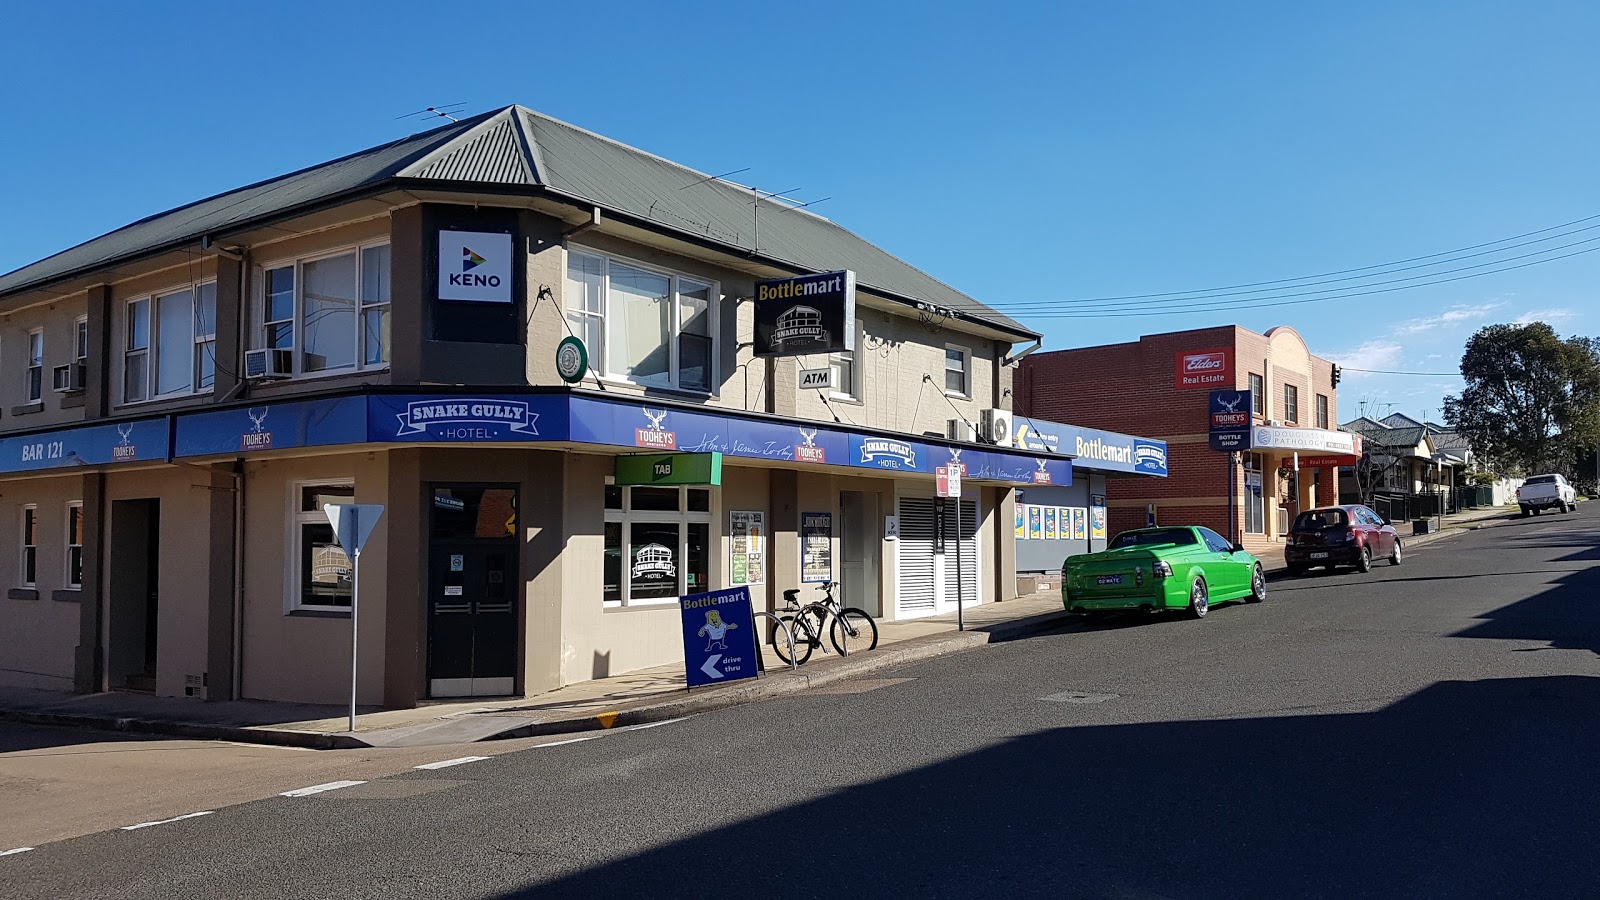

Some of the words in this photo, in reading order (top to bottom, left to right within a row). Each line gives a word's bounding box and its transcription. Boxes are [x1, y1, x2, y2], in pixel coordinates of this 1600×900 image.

[450, 273, 500, 288] KENO
[760, 275, 841, 300] Bottlemart
[777, 328, 799, 338] SNAKE
[799, 327, 820, 335] GULLY
[1187, 358, 1221, 370] Elders
[803, 372, 828, 385] ATM
[1183, 376, 1200, 385] Real
[1201, 374, 1225, 383] Estate
[413, 405, 468, 420] SNAKE
[471, 404, 524, 419] GULLY
[1215, 414, 1245, 422] TOOHEYS
[243, 432, 271, 446] TOOHEYS
[446, 428, 492, 439] HOTEL
[638, 430, 673, 444] TOOHEYS
[867, 442, 889, 452] SNAKE
[1274, 438, 1324, 446] PATHOLOGY
[22, 443, 44, 461] BAR
[47, 441, 63, 459] 121
[113, 446, 135, 457] TOOHEYS
[797, 446, 823, 459] TOOHEYS
[1076, 435, 1132, 464] Bottlemart
[881, 459, 899, 468] HOTEL
[654, 464, 671, 475] TAB
[950, 468, 959, 476] 1P
[332, 566, 348, 574] GULLY
[683, 591, 746, 610] Bottlemart
[723, 656, 742, 664] drive
[725, 664, 741, 672] thru
